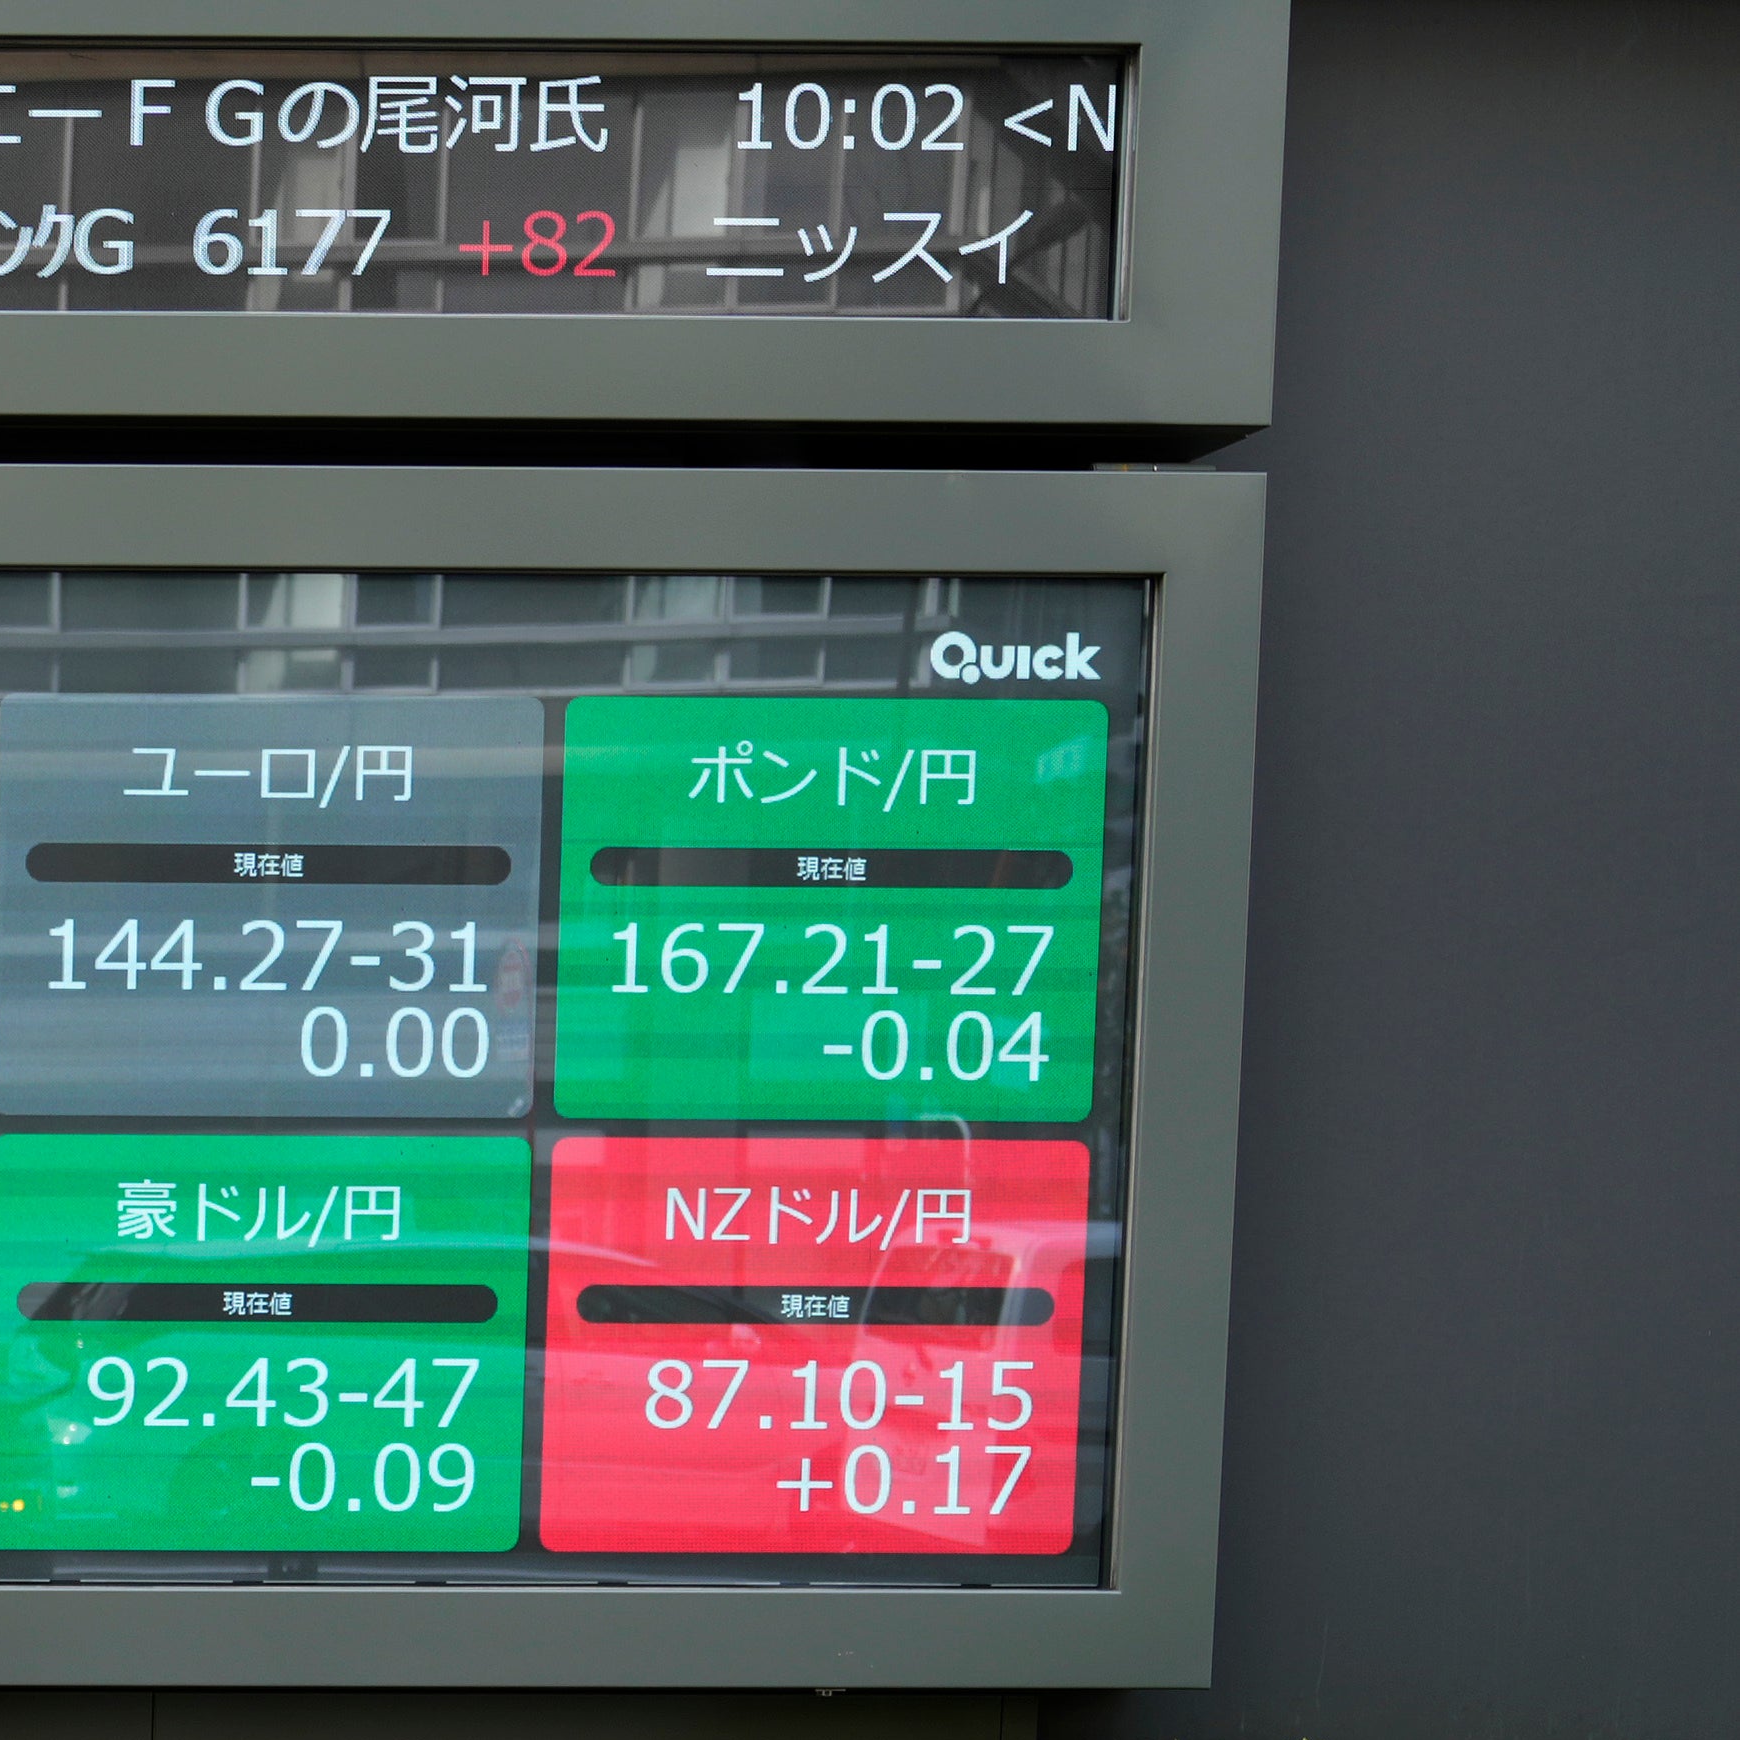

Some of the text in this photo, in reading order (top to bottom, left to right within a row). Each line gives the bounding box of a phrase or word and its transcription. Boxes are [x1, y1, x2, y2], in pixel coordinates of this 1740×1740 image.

[736, 83, 964, 151] 10:02
[190, 207, 392, 277] 6177
[456, 208, 618, 278] +82
[705, 209, 1034, 285] ニッスイ
[122, 745, 414, 809] ユーロ/円
[688, 740, 978, 813] ポンド/円
[233, 852, 304, 878] 現在値
[796, 856, 867, 882] 現在値
[48, 918, 488, 992] 144.27-31
[611, 922, 1054, 996] 167.21-27
[300, 1006, 490, 1079] 0.00
[823, 1010, 1049, 1082] -0.04
[116, 1178, 402, 1248] 豪ドル/円
[664, 1186, 973, 1252] NZドル/円
[222, 1290, 293, 1316] 現在値
[780, 1294, 851, 1319] 現在値
[86, 1356, 480, 1429] 92.43-47
[644, 1358, 1035, 1432] 87.10-15
[250, 1442, 476, 1512] -0.09
[776, 1444, 1033, 1516] +0.17
